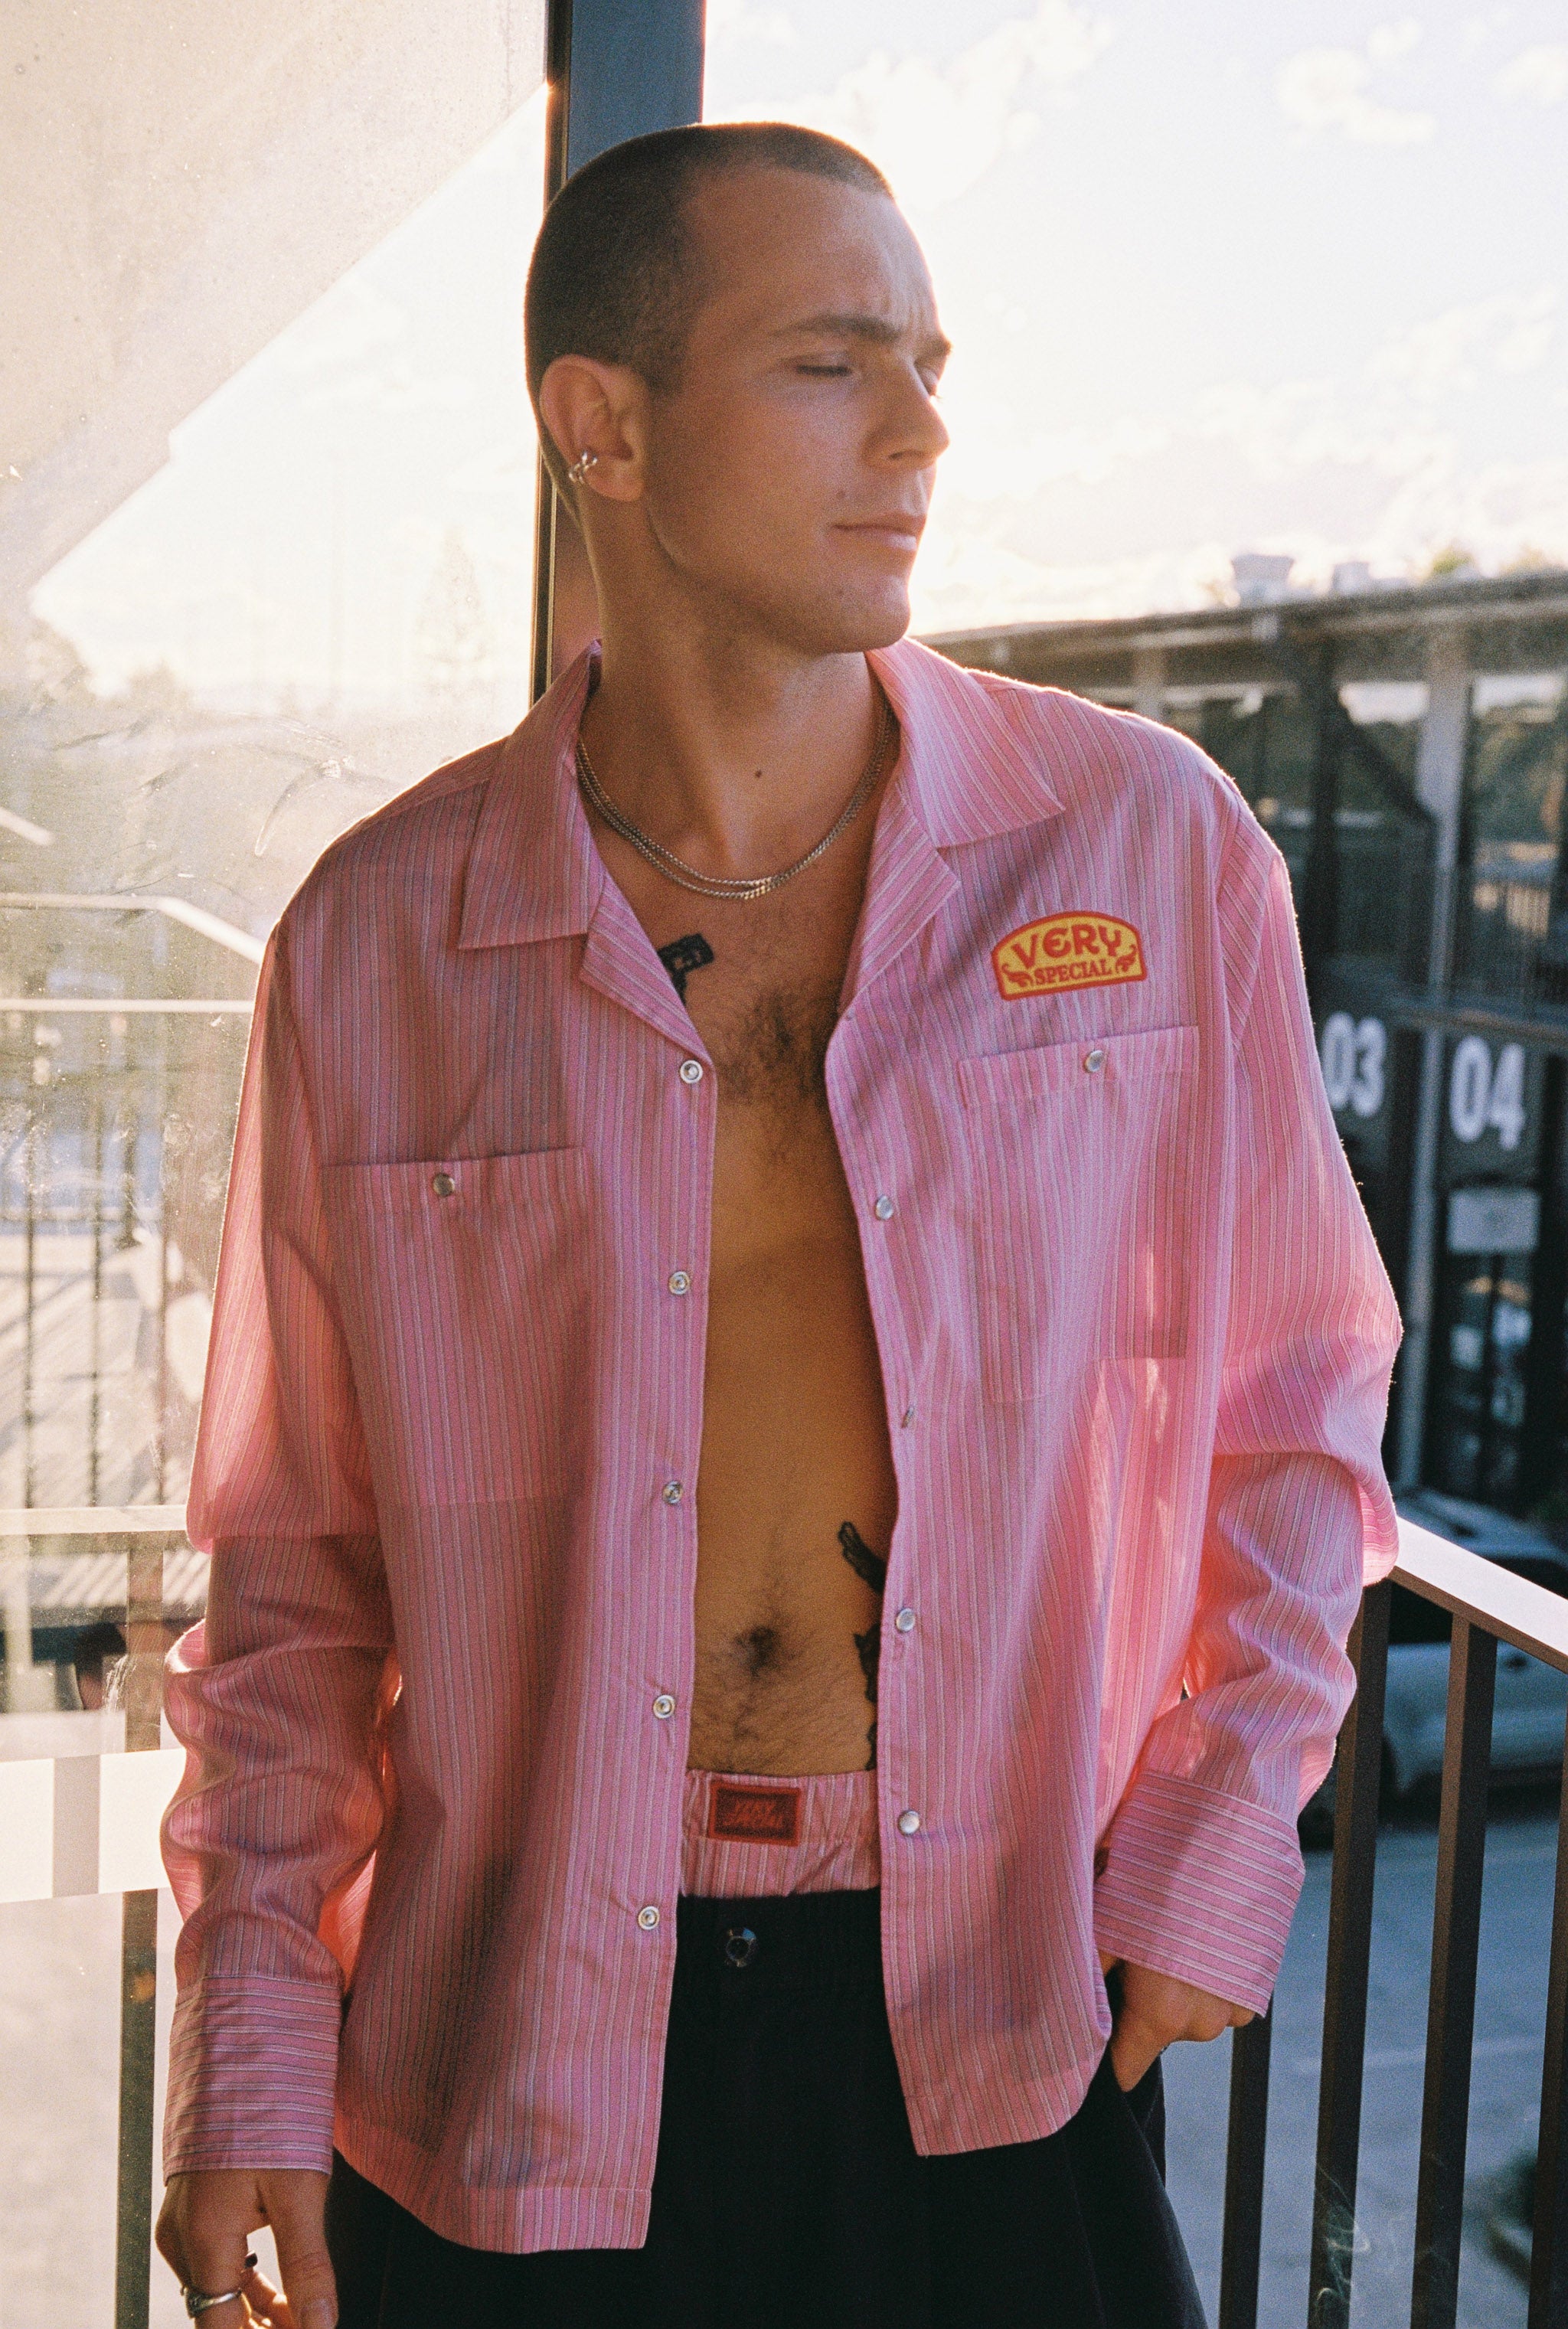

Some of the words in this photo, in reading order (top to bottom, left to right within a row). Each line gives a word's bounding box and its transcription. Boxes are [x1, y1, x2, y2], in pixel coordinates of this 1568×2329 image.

[1011, 923, 1122, 969] VERY
[1034, 959, 1110, 985] SPECIAL
[1322, 1011, 1386, 1117] 03
[1451, 1036, 1525, 1149] 04
